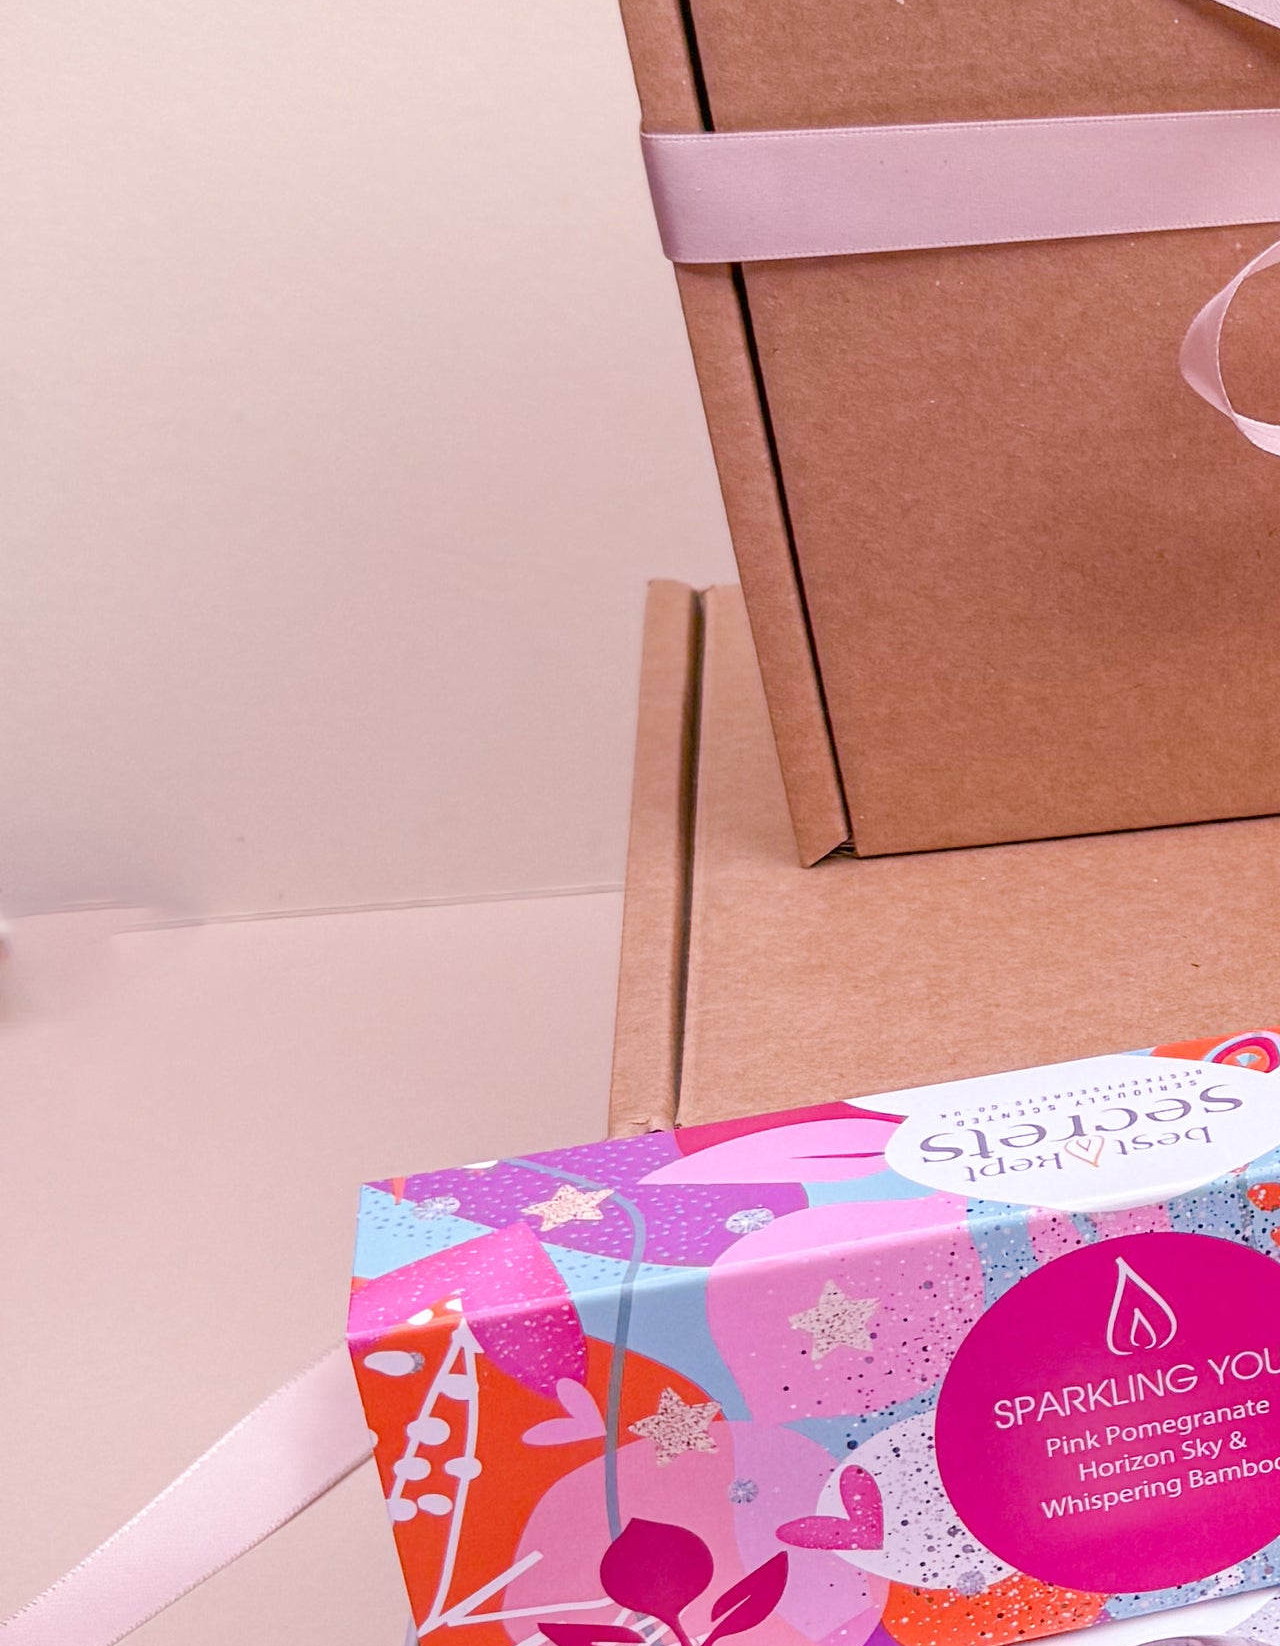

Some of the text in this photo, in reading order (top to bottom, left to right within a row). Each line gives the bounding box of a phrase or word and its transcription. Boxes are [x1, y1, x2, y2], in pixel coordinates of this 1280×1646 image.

[919, 1083, 1243, 1163] secrets
[956, 1079, 1198, 1127] SERIOUSLY SCENTED
[964, 1126, 1213, 1182] best kept
[993, 1363, 1198, 1430] SPARKLING
[1046, 1398, 1271, 1458] Pink Pomegranate
[1078, 1430, 1248, 1482] Horizon Sky &
[1040, 1473, 1182, 1519] Whispering
